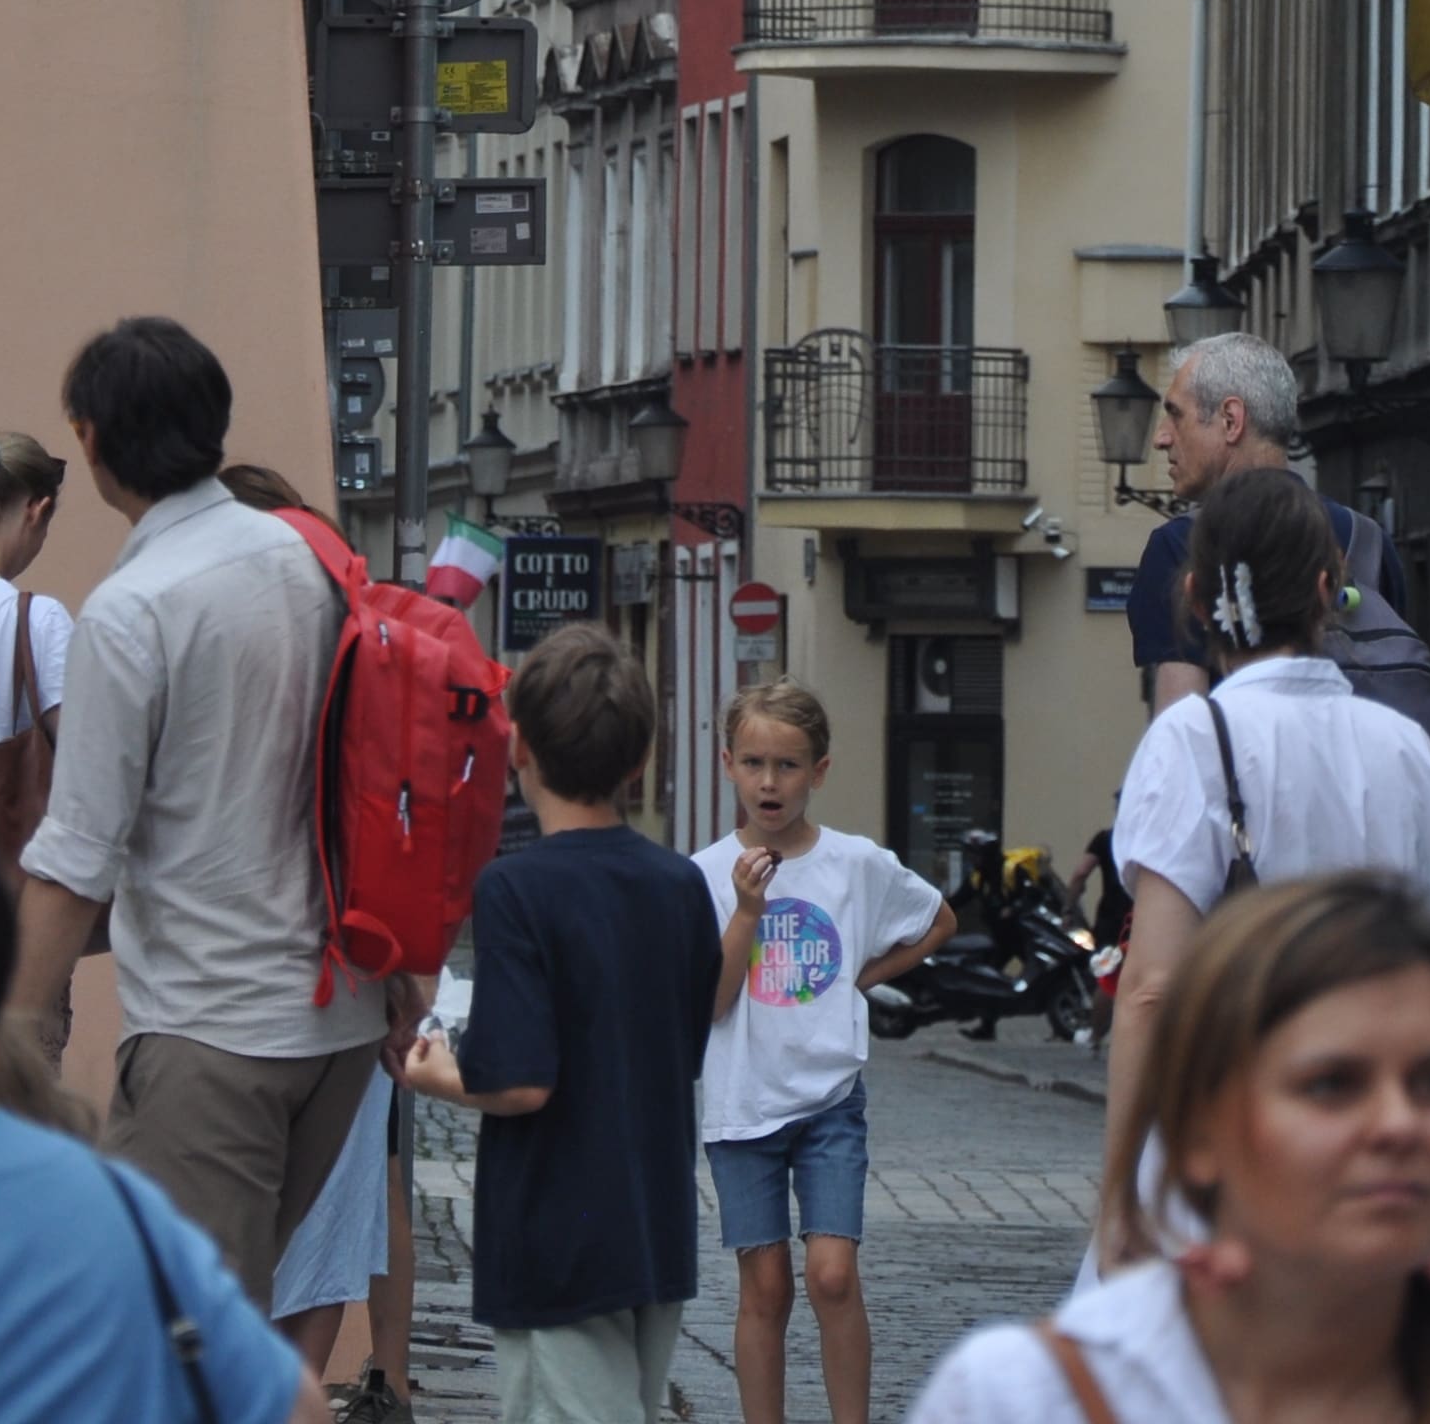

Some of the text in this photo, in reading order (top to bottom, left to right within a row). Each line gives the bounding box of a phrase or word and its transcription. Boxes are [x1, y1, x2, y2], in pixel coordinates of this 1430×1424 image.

[514, 554, 590, 575] COTTO
[513, 589, 588, 611] CRUDO
[761, 914, 800, 940] THE
[760, 939, 830, 966] COLOR
[760, 965, 803, 993] RUN
